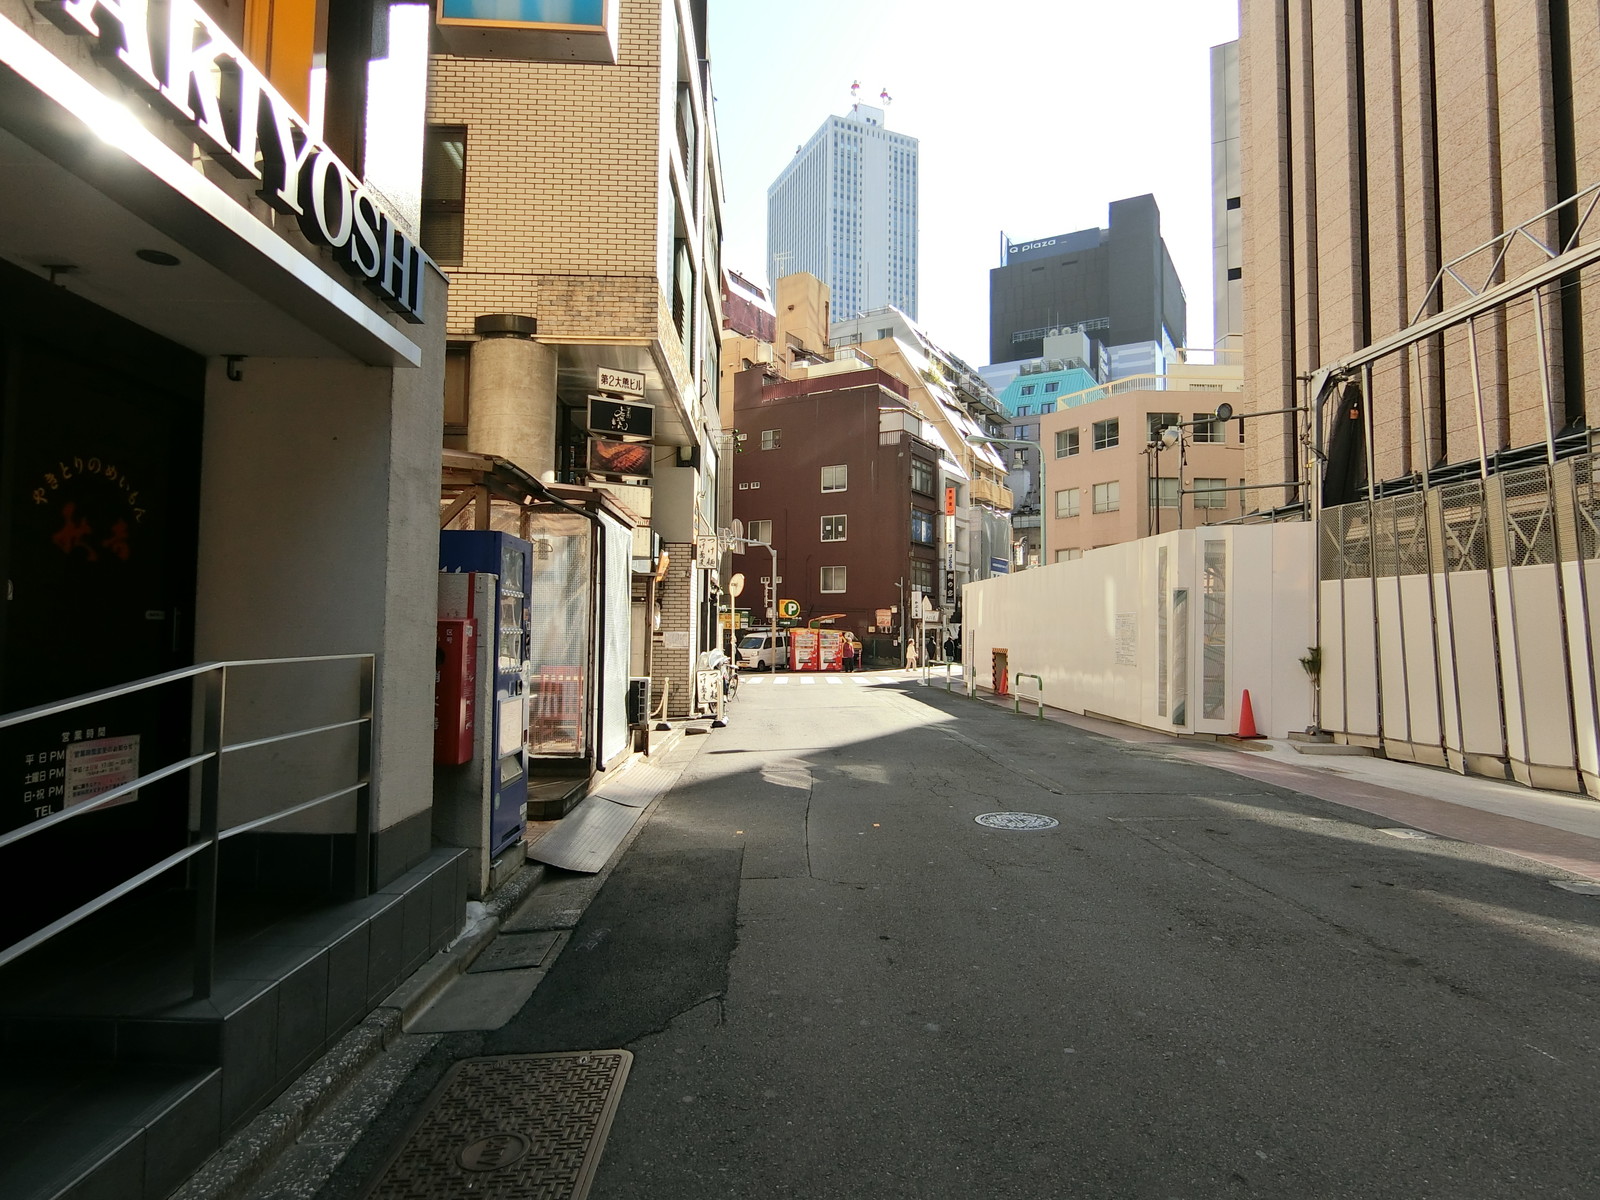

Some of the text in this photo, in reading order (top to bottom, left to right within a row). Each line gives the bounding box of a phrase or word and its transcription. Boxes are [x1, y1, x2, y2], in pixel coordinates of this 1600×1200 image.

[1009, 246, 1019, 254] Q
[1021, 239, 1056, 252] plaza
[601, 374, 642, 391] 第2大熊ビル
[788, 603, 798, 616] P
[62, 727, 106, 742] 営業時間
[50, 749, 65, 762] PM
[25, 770, 46, 785] 土曜日
[49, 767, 64, 780] PM
[48, 785, 63, 798] PM
[35, 805, 54, 818] TEL
